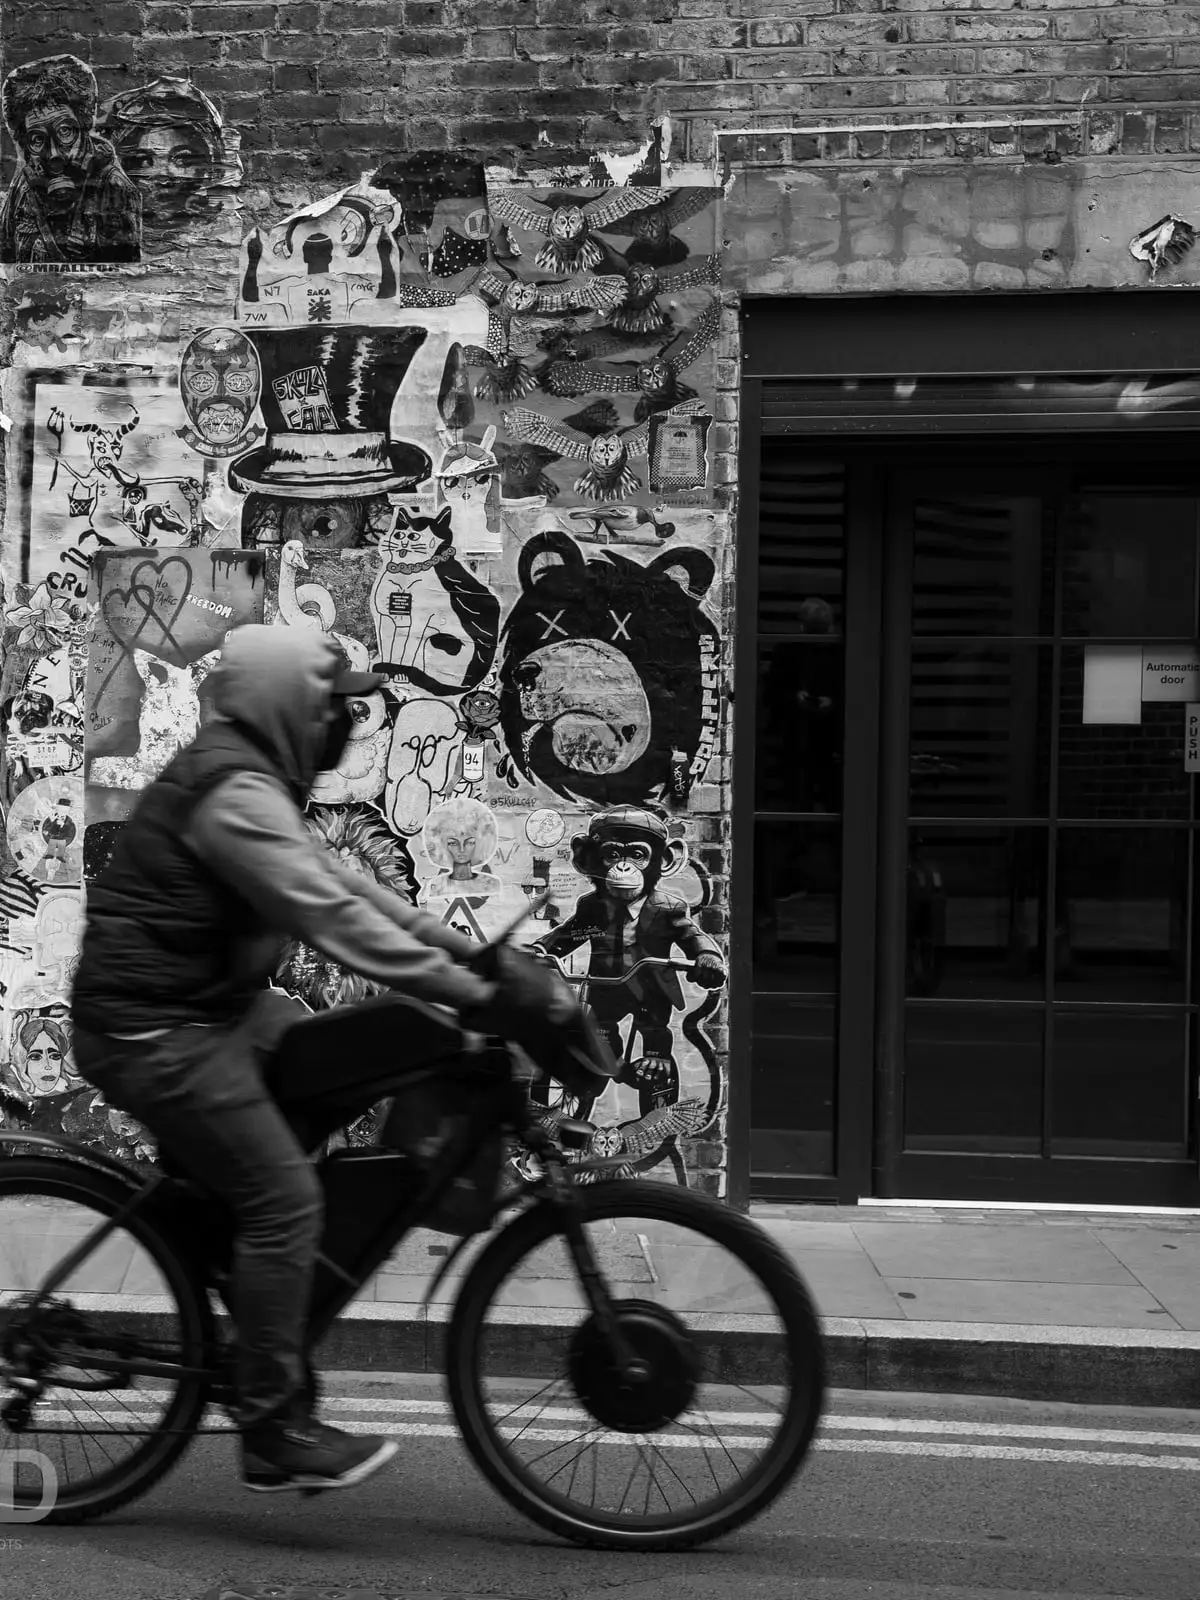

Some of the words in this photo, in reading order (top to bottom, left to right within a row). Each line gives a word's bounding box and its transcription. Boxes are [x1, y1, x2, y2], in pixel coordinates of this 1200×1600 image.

[306, 288, 332, 297] SAKA
[1160, 675, 1186, 684] door
[1188, 716, 1198, 760] PUSH
[464, 752, 480, 765] 94
